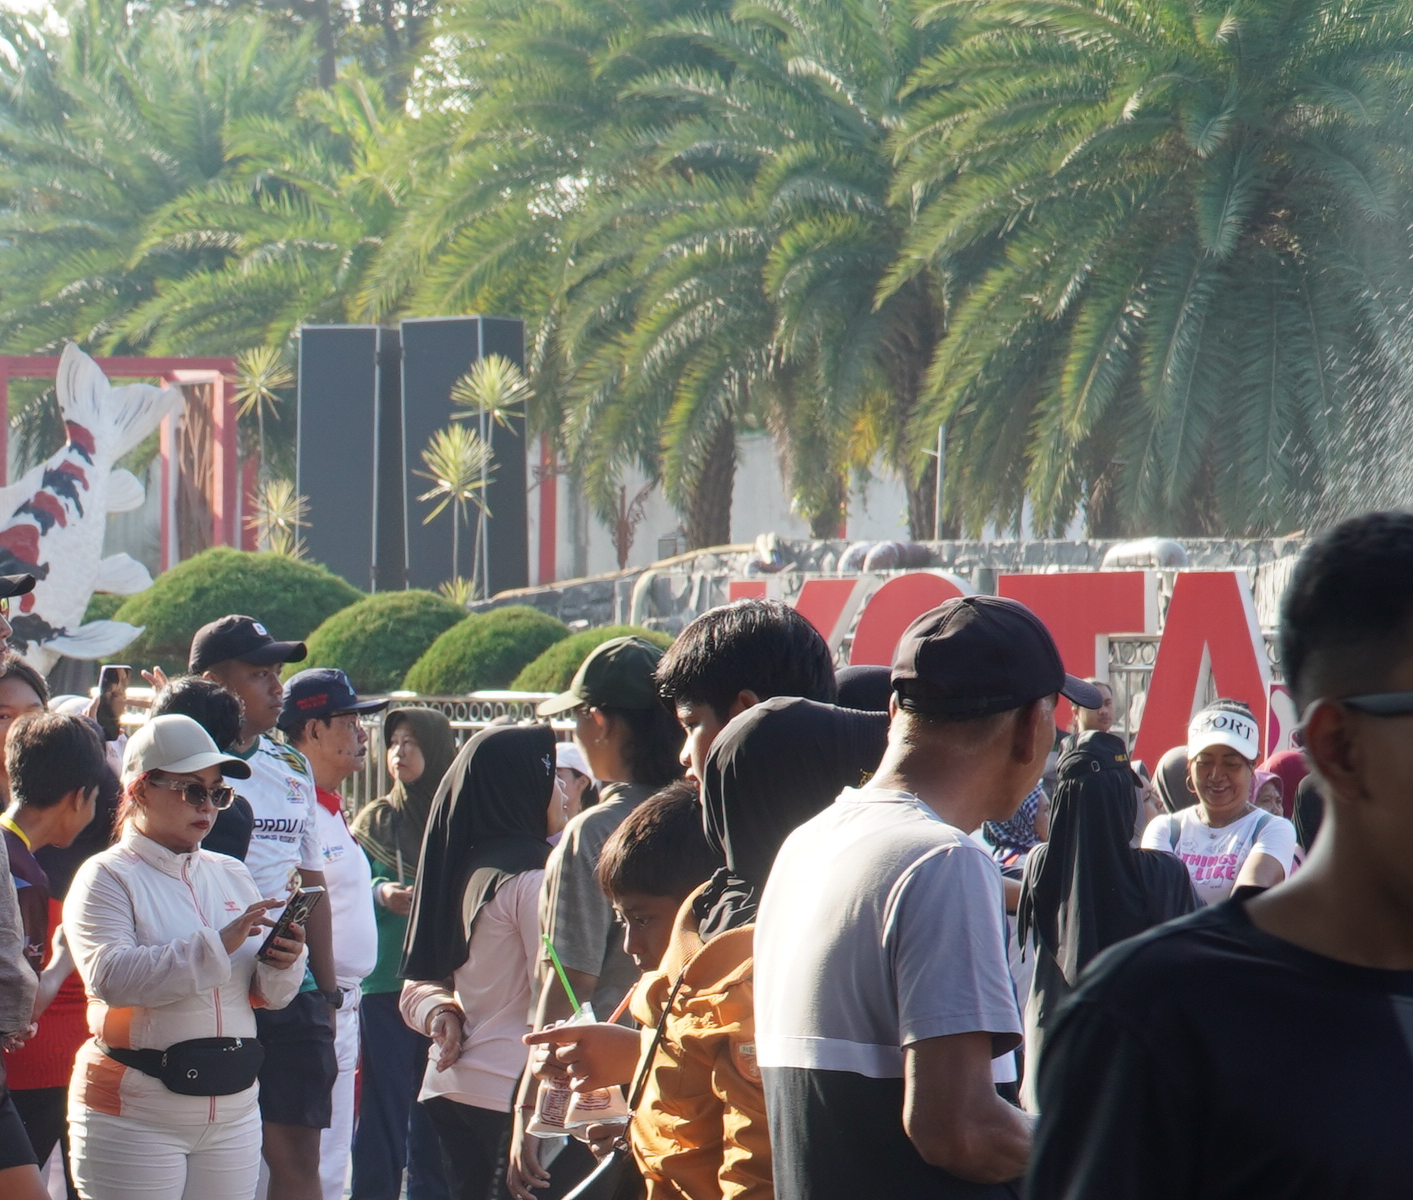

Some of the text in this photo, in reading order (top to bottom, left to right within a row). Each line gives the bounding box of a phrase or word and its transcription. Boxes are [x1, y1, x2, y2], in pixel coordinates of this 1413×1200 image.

[730, 571, 1270, 778] TA
[1182, 853, 1238, 868] THINGS
[1195, 867, 1236, 880] LIKE
